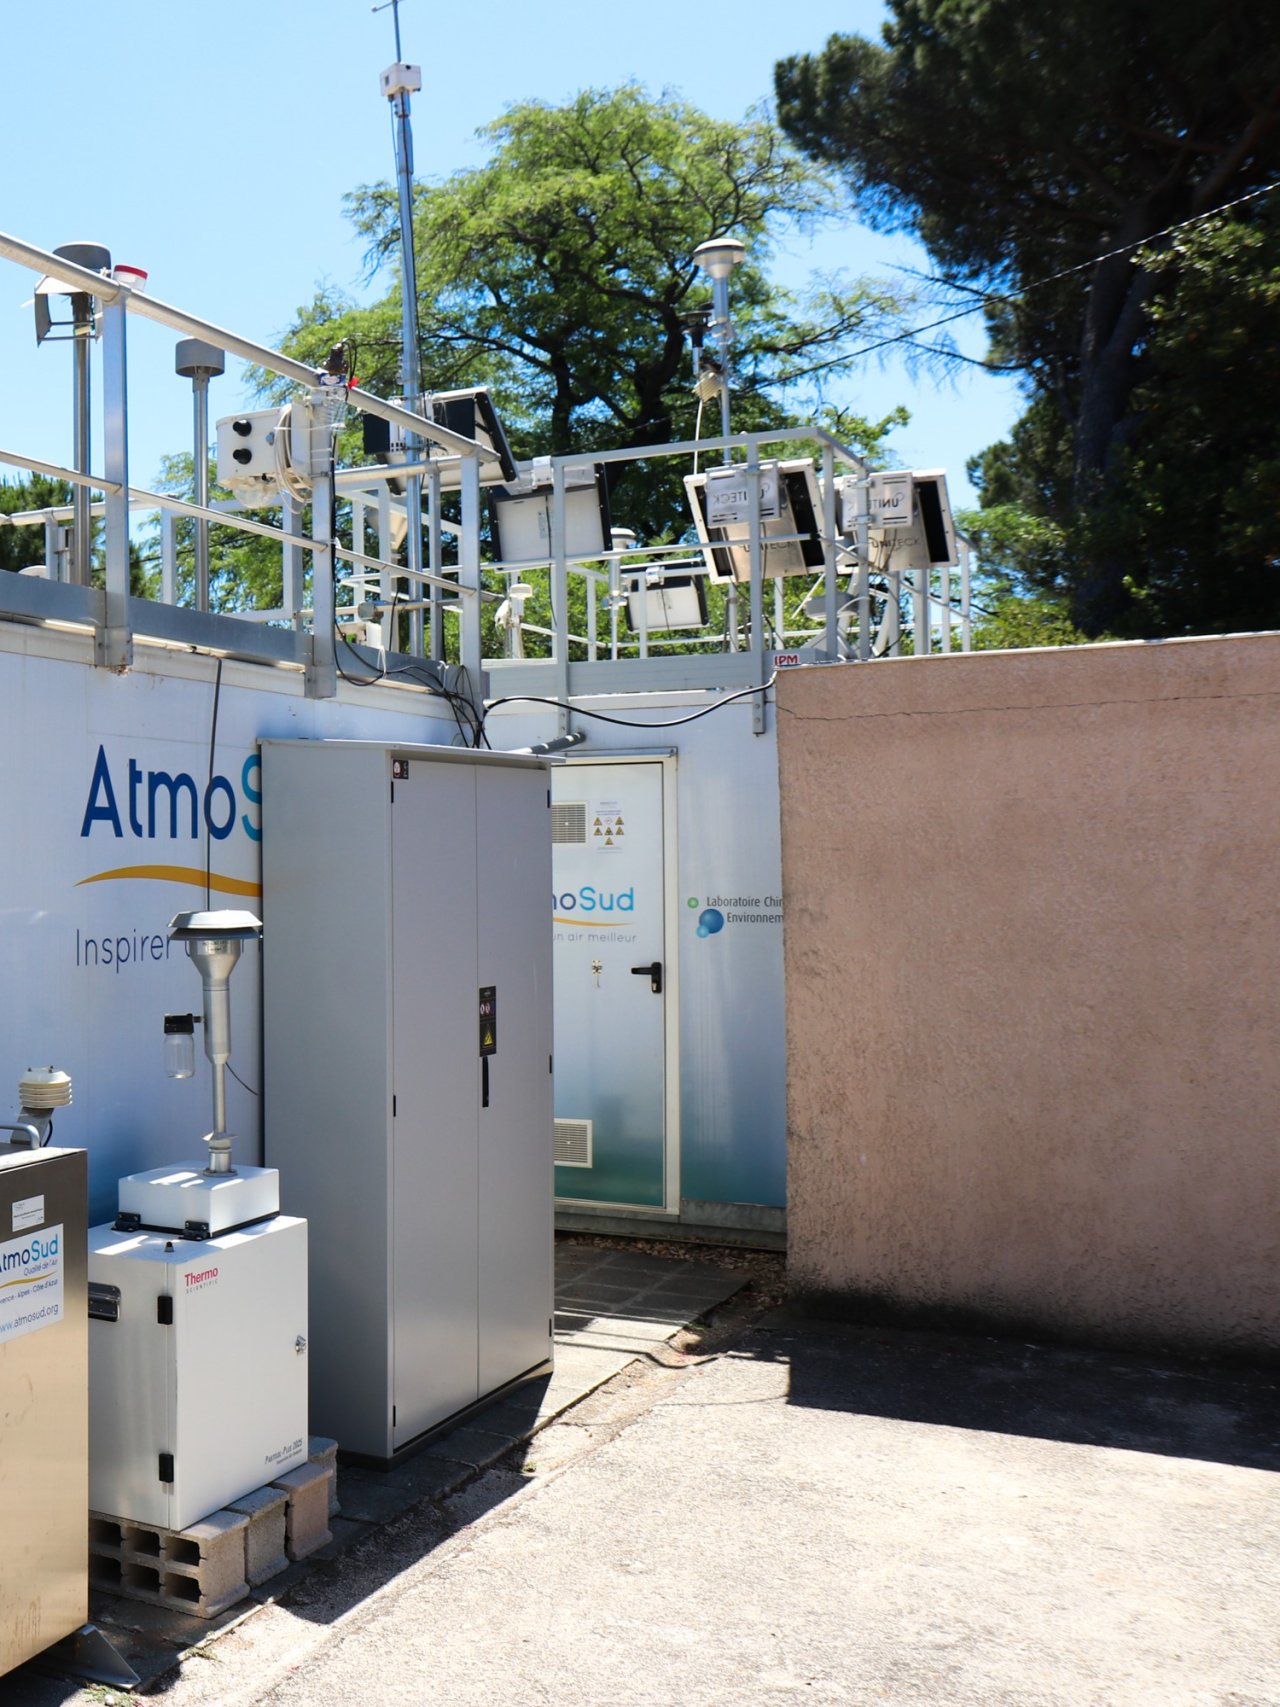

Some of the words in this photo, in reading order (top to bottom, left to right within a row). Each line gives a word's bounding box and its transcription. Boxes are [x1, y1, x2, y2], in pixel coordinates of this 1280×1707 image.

[706, 896, 760, 907] Laboratoire
[568, 932, 583, 942] air
[588, 932, 637, 943] meilleur
[76, 928, 171, 974] Inspirer
[185, 1267, 218, 1287] Thermo
[186, 1279, 218, 1294] SCIENTIFIC
[17, 1289, 30, 1299] Alpes
